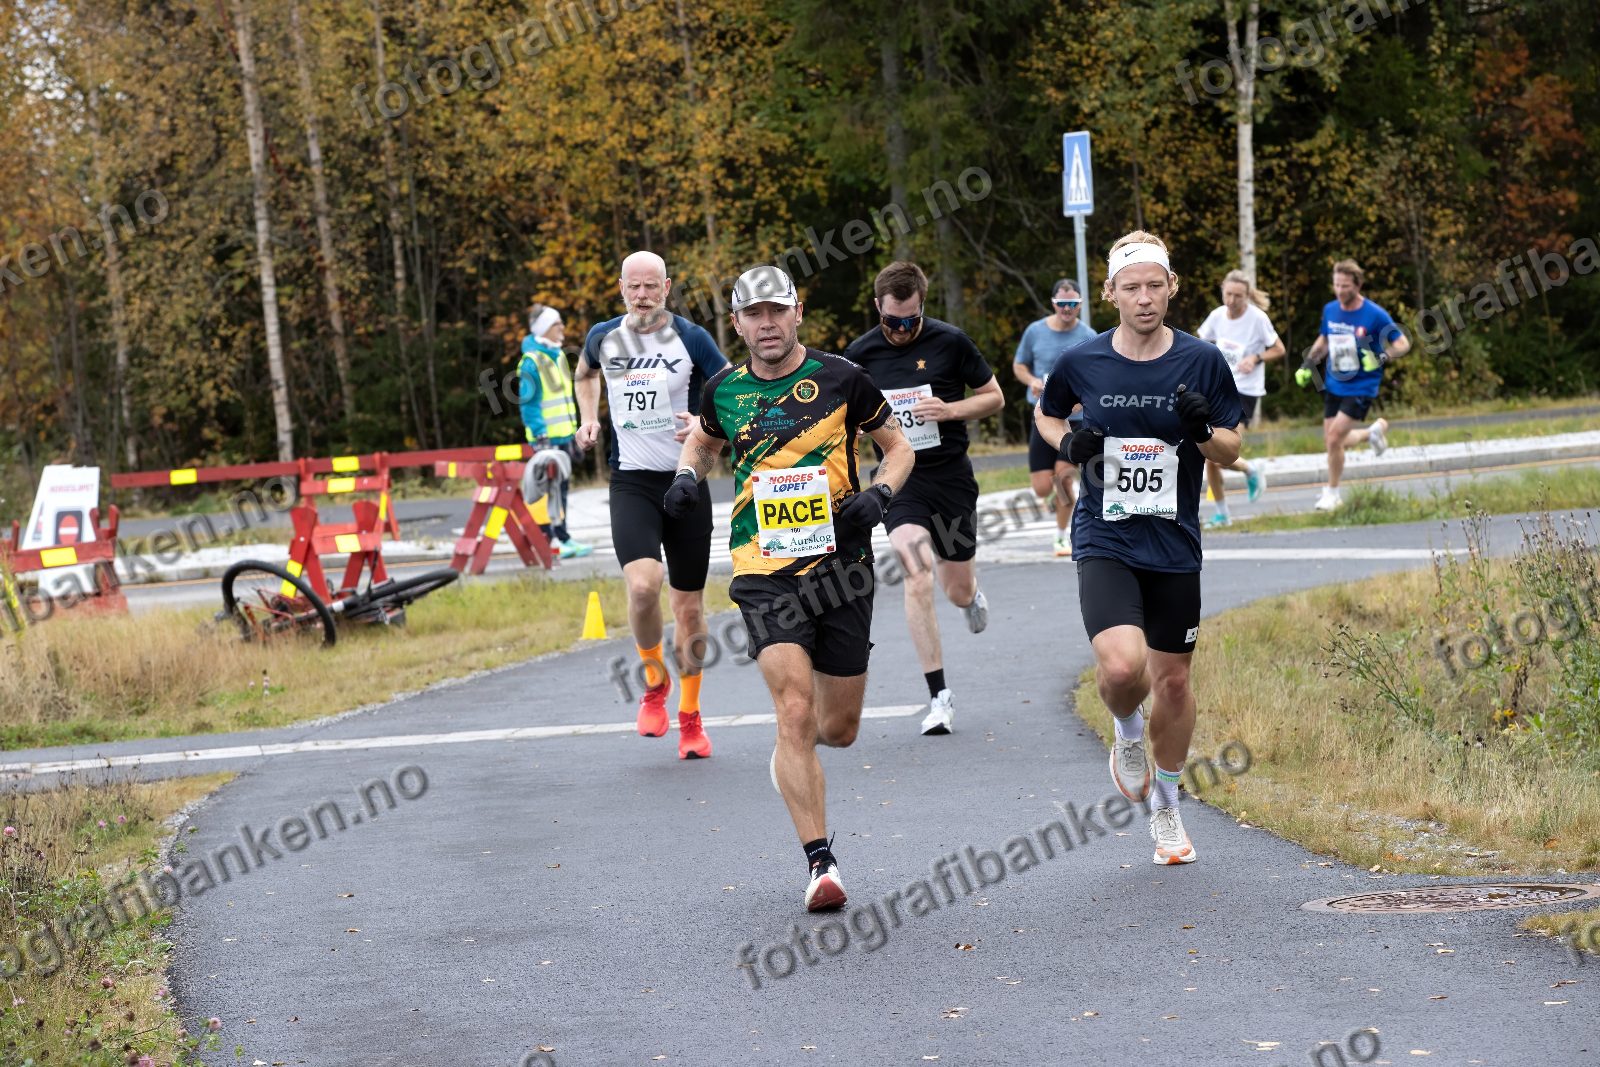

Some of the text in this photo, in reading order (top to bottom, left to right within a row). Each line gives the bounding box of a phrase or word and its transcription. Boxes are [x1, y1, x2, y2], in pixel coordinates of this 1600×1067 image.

[624, 391, 657, 411] 797
[890, 391, 922, 400] NORGES
[894, 398, 917, 406] LØPET
[1100, 395, 1166, 408] CRAFT
[640, 417, 672, 427] Aurskog
[759, 418, 796, 428] Aurskog
[1120, 444, 1165, 453] NORGES
[1125, 453, 1159, 461] LØPET
[769, 473, 814, 485] NORGES
[1117, 467, 1164, 493] 505
[773, 482, 807, 493] LØPET
[763, 498, 826, 525] PACE
[790, 533, 832, 546] Aurskog
